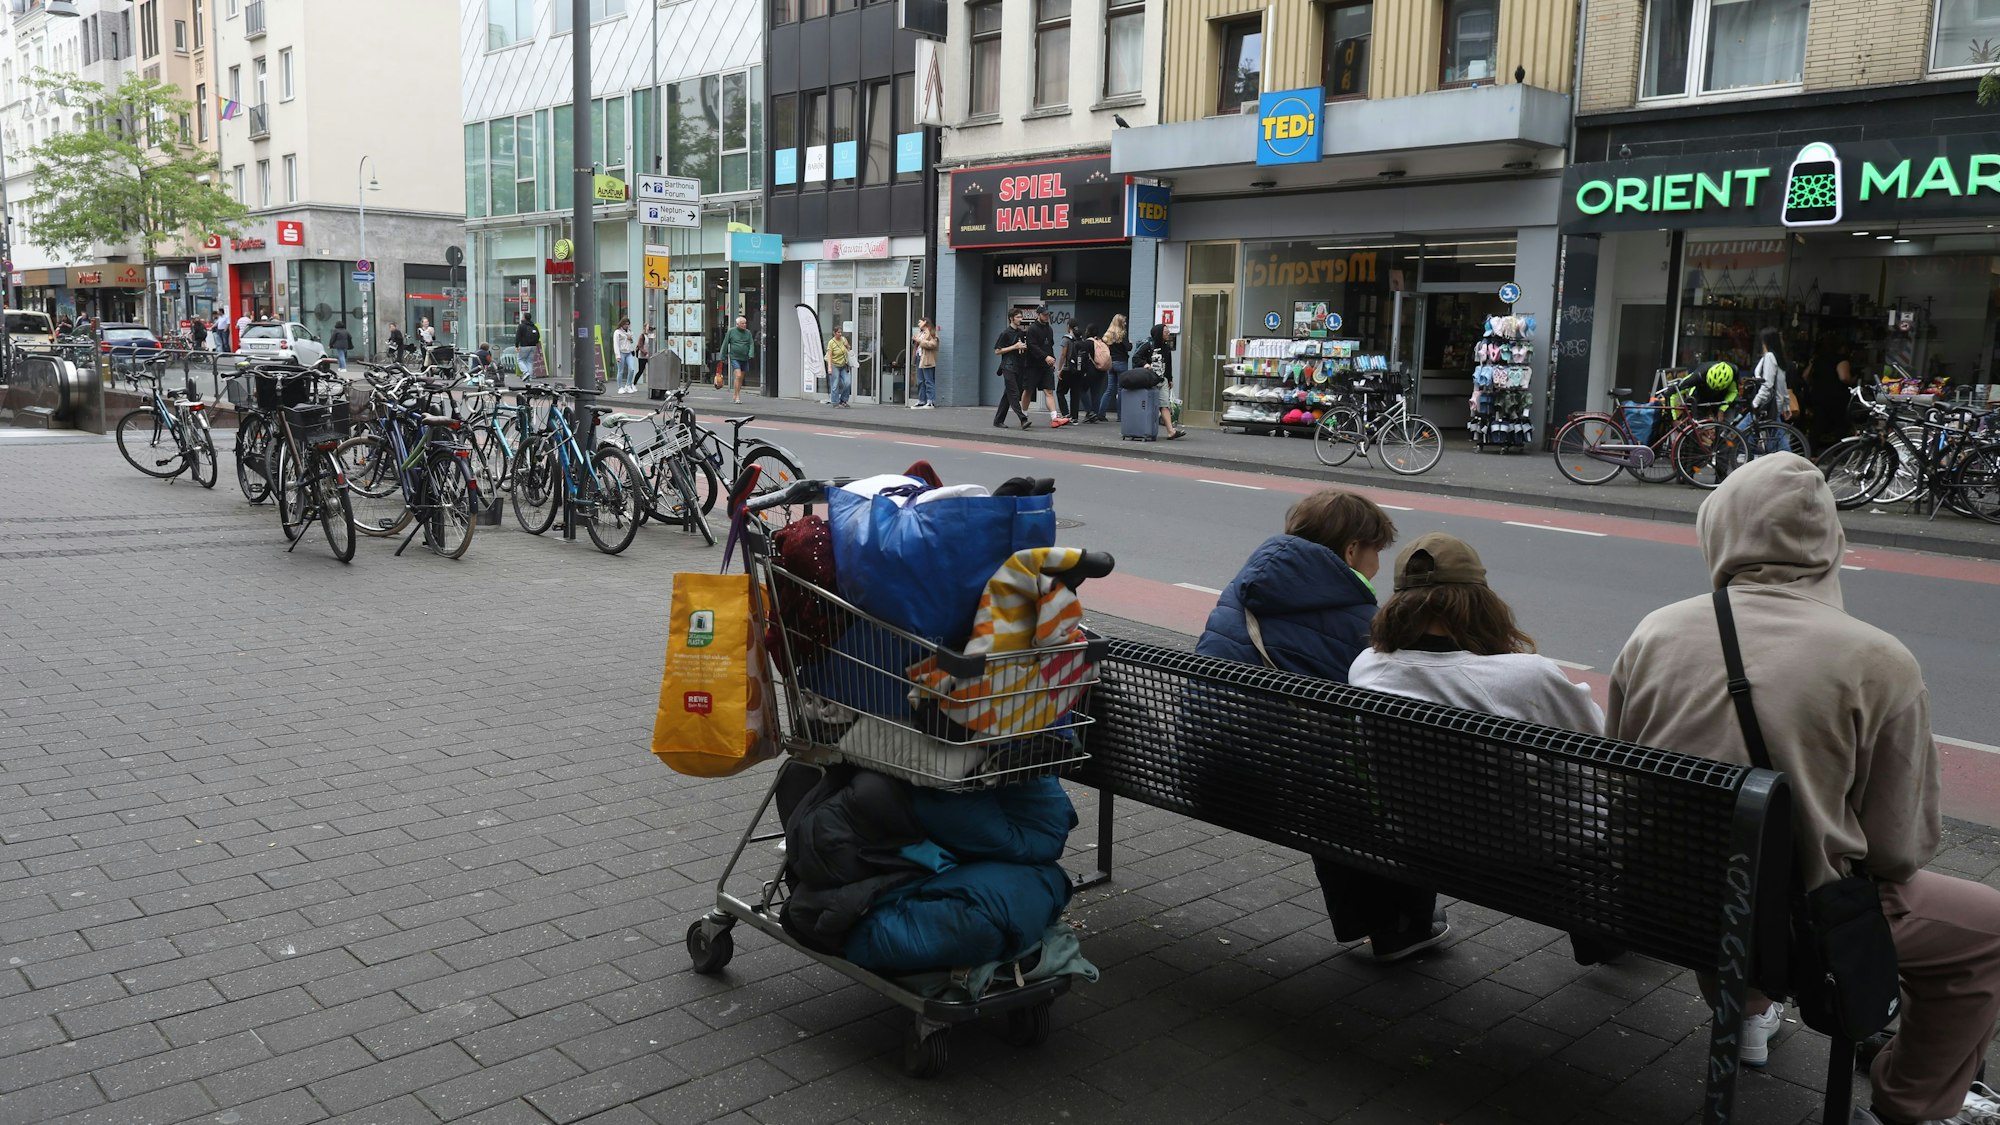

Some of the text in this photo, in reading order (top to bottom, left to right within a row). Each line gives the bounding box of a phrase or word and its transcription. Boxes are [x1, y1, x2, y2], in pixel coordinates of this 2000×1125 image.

[1262, 112, 1315, 141] TEDi
[664, 180, 695, 190] Barthonia
[999, 173, 1066, 201] SPIEL
[664, 189, 686, 198] Forum
[1575, 167, 1771, 215] ORIENT
[660, 206, 686, 215] Neptun-
[1137, 201, 1168, 220] TEDi
[660, 215, 676, 224] platz
[996, 204, 1069, 233] HALLE
[1081, 216, 1112, 225] SPIELHALLE
[960, 224, 986, 232] SPIELHALLE
[647, 257, 654, 267] U
[1002, 263, 1042, 278] EINGANG
[1046, 288, 1069, 297] SPIEL
[1085, 289, 1126, 298] SPIELHALLE
[688, 695, 709, 703] REWE
